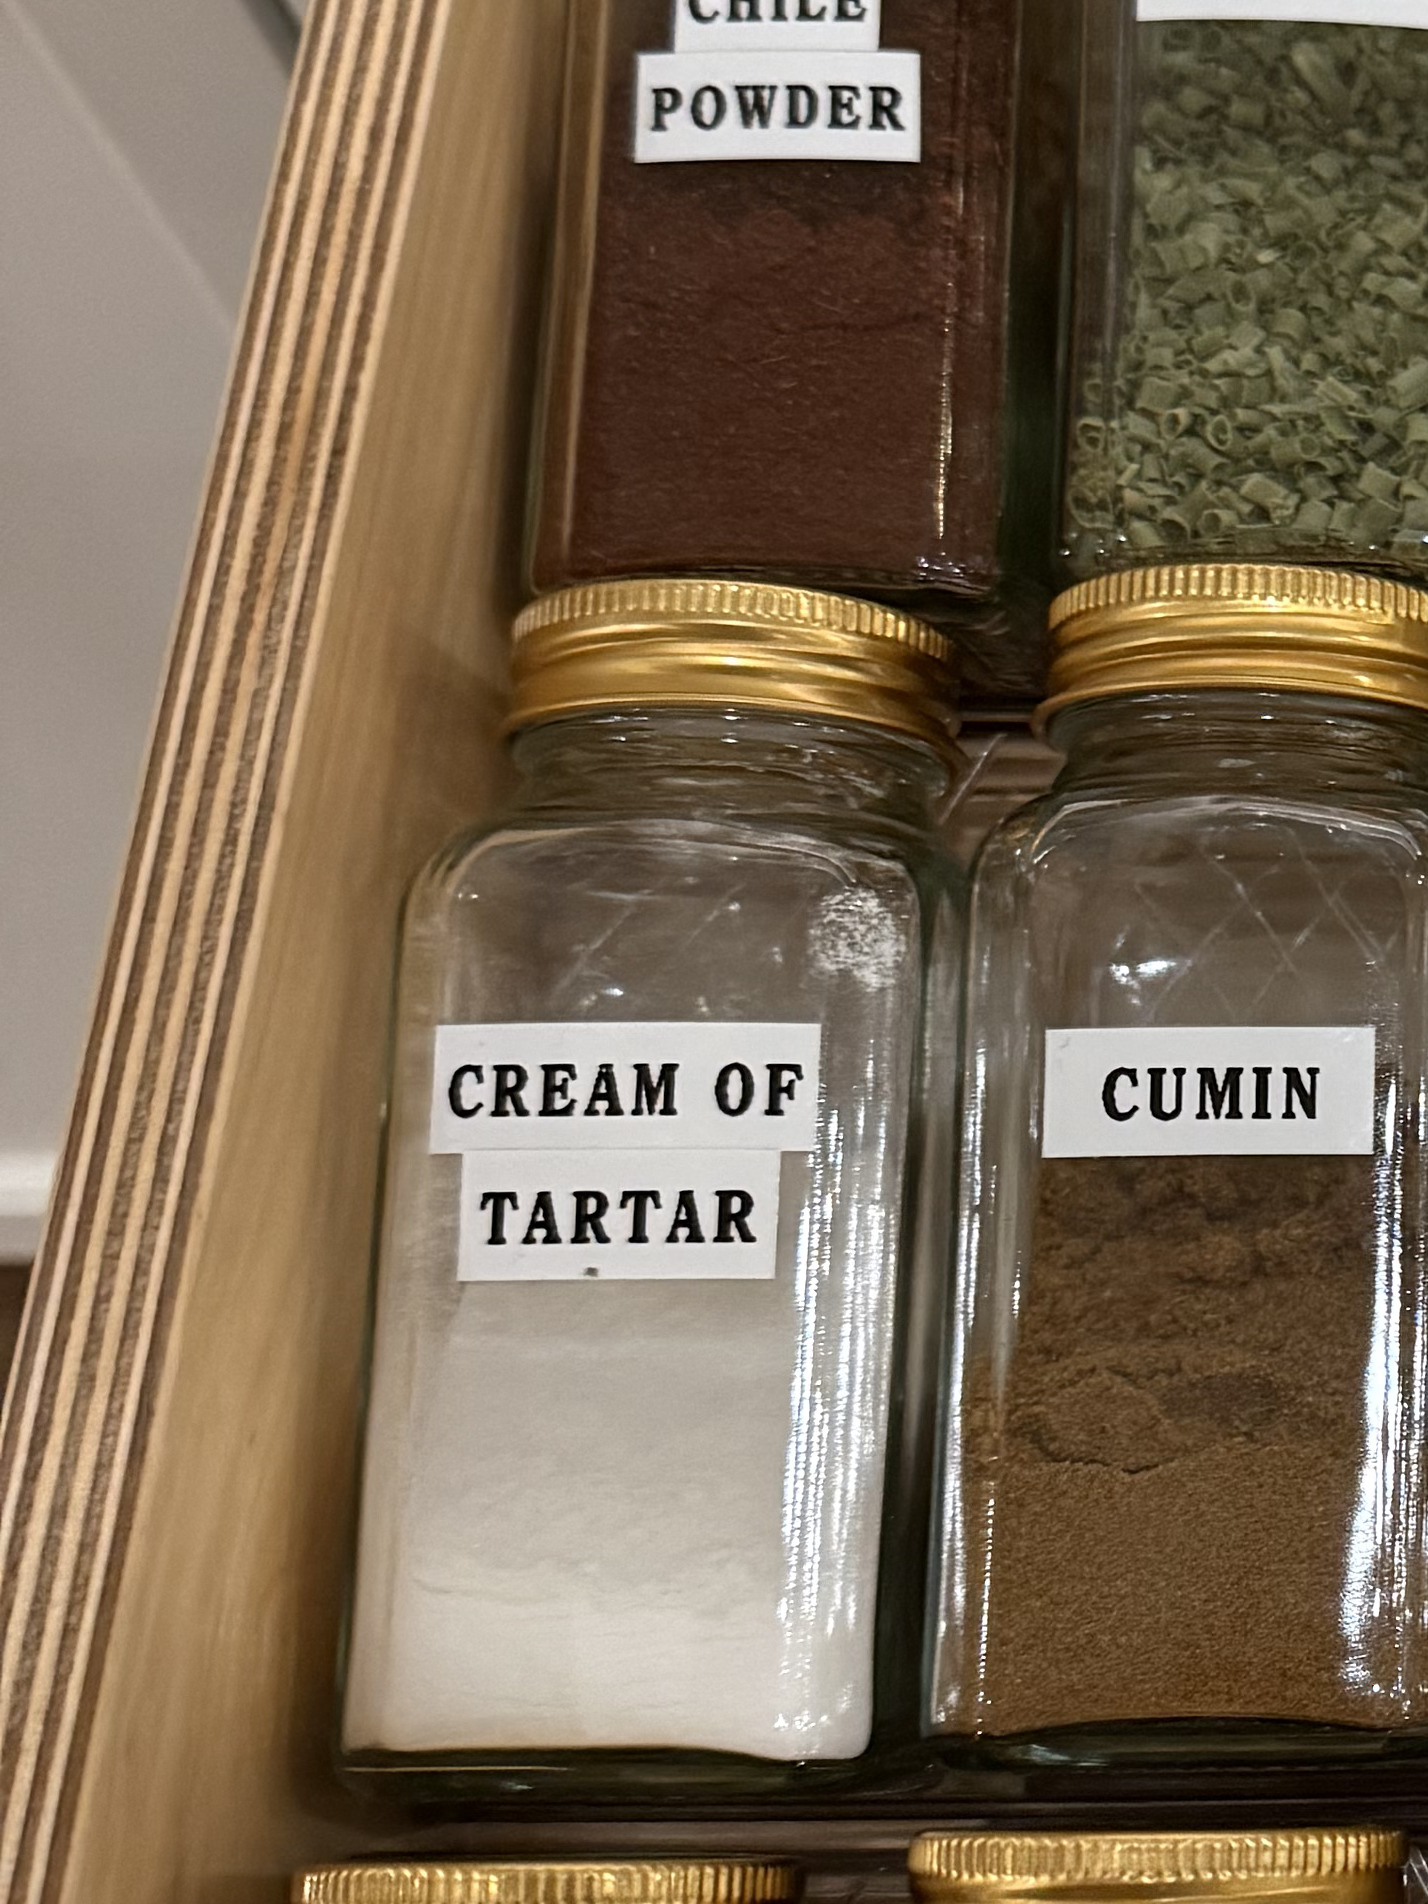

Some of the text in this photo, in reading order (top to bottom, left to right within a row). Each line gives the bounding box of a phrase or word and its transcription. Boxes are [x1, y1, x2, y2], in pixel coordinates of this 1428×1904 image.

[650, 85, 905, 132] POWDER
[448, 1062, 804, 1119] CREAM OF
[1102, 1067, 1320, 1122] CUMIN
[480, 1190, 757, 1245] TARTAR
